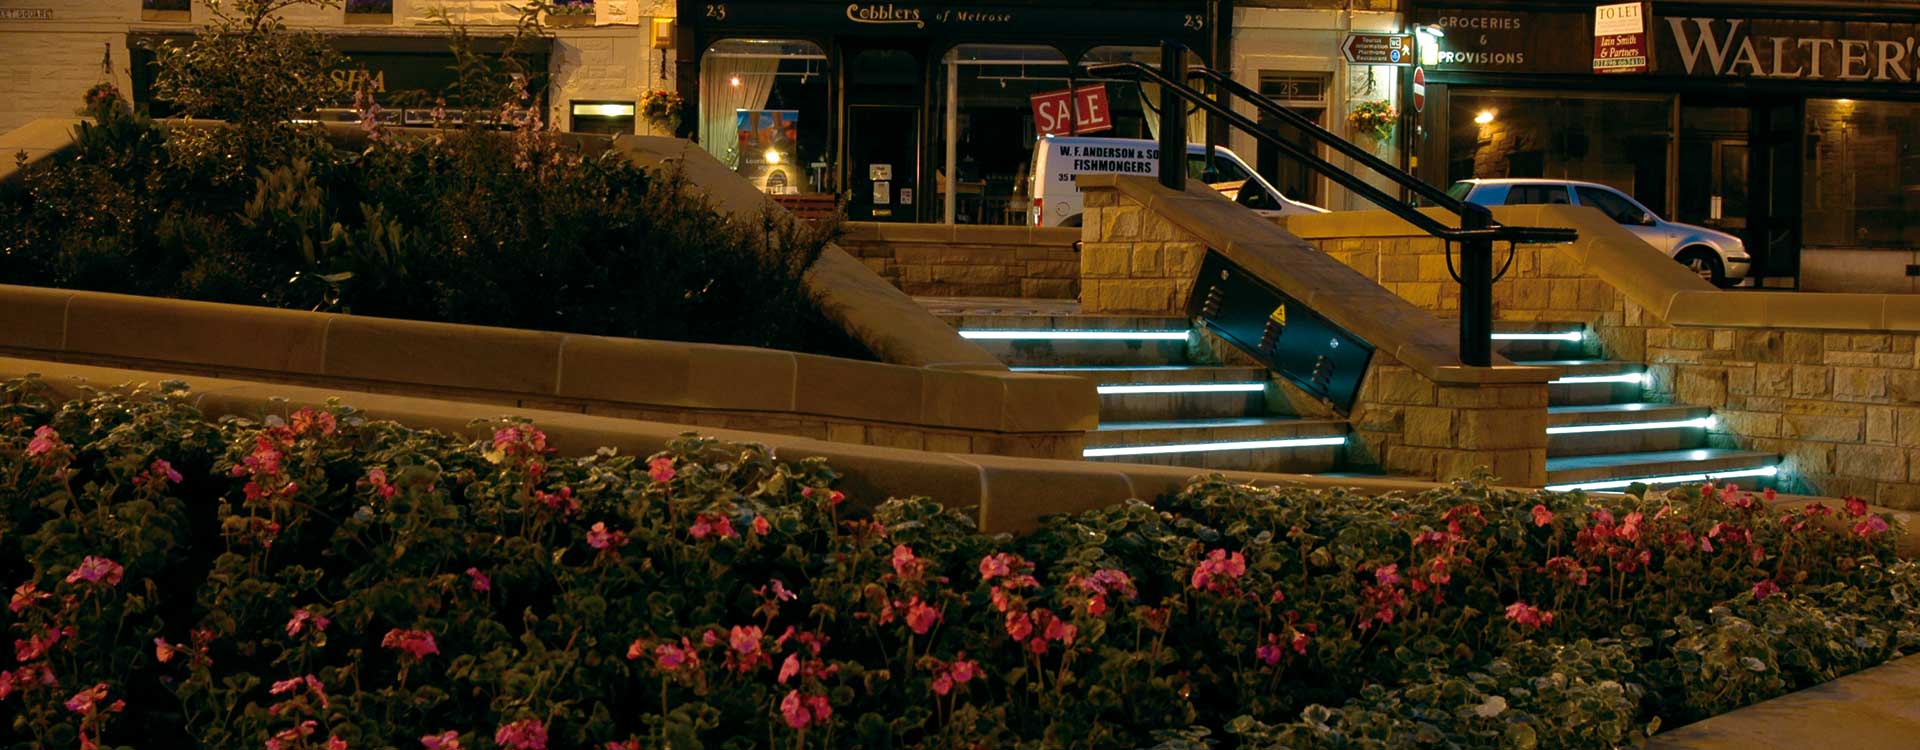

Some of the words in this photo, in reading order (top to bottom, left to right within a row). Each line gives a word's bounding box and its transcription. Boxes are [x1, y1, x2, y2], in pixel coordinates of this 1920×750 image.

[706, 3, 727, 20] 23
[846, 3, 925, 29] Cobblers
[936, 10, 951, 22] of
[1600, 8, 1614, 20] TO
[1618, 5, 1639, 18] LET
[1184, 14, 1203, 30] 23
[1439, 16, 1521, 29] GROCERIES
[1616, 35, 1637, 46] Smith
[1610, 47, 1640, 58] Partners
[1664, 16, 1920, 83] WALTER'
[1439, 51, 1524, 64] PROVISIONS
[1280, 82, 1298, 95] 25
[1039, 94, 1104, 132] SALE
[1060, 146, 1073, 157] W.
[1083, 147, 1135, 159] ANDERSON
[1137, 150, 1145, 159] &
[1146, 149, 1160, 160] SO
[1074, 160, 1152, 173] FISHMONGERS
[1058, 174, 1069, 182] 35
